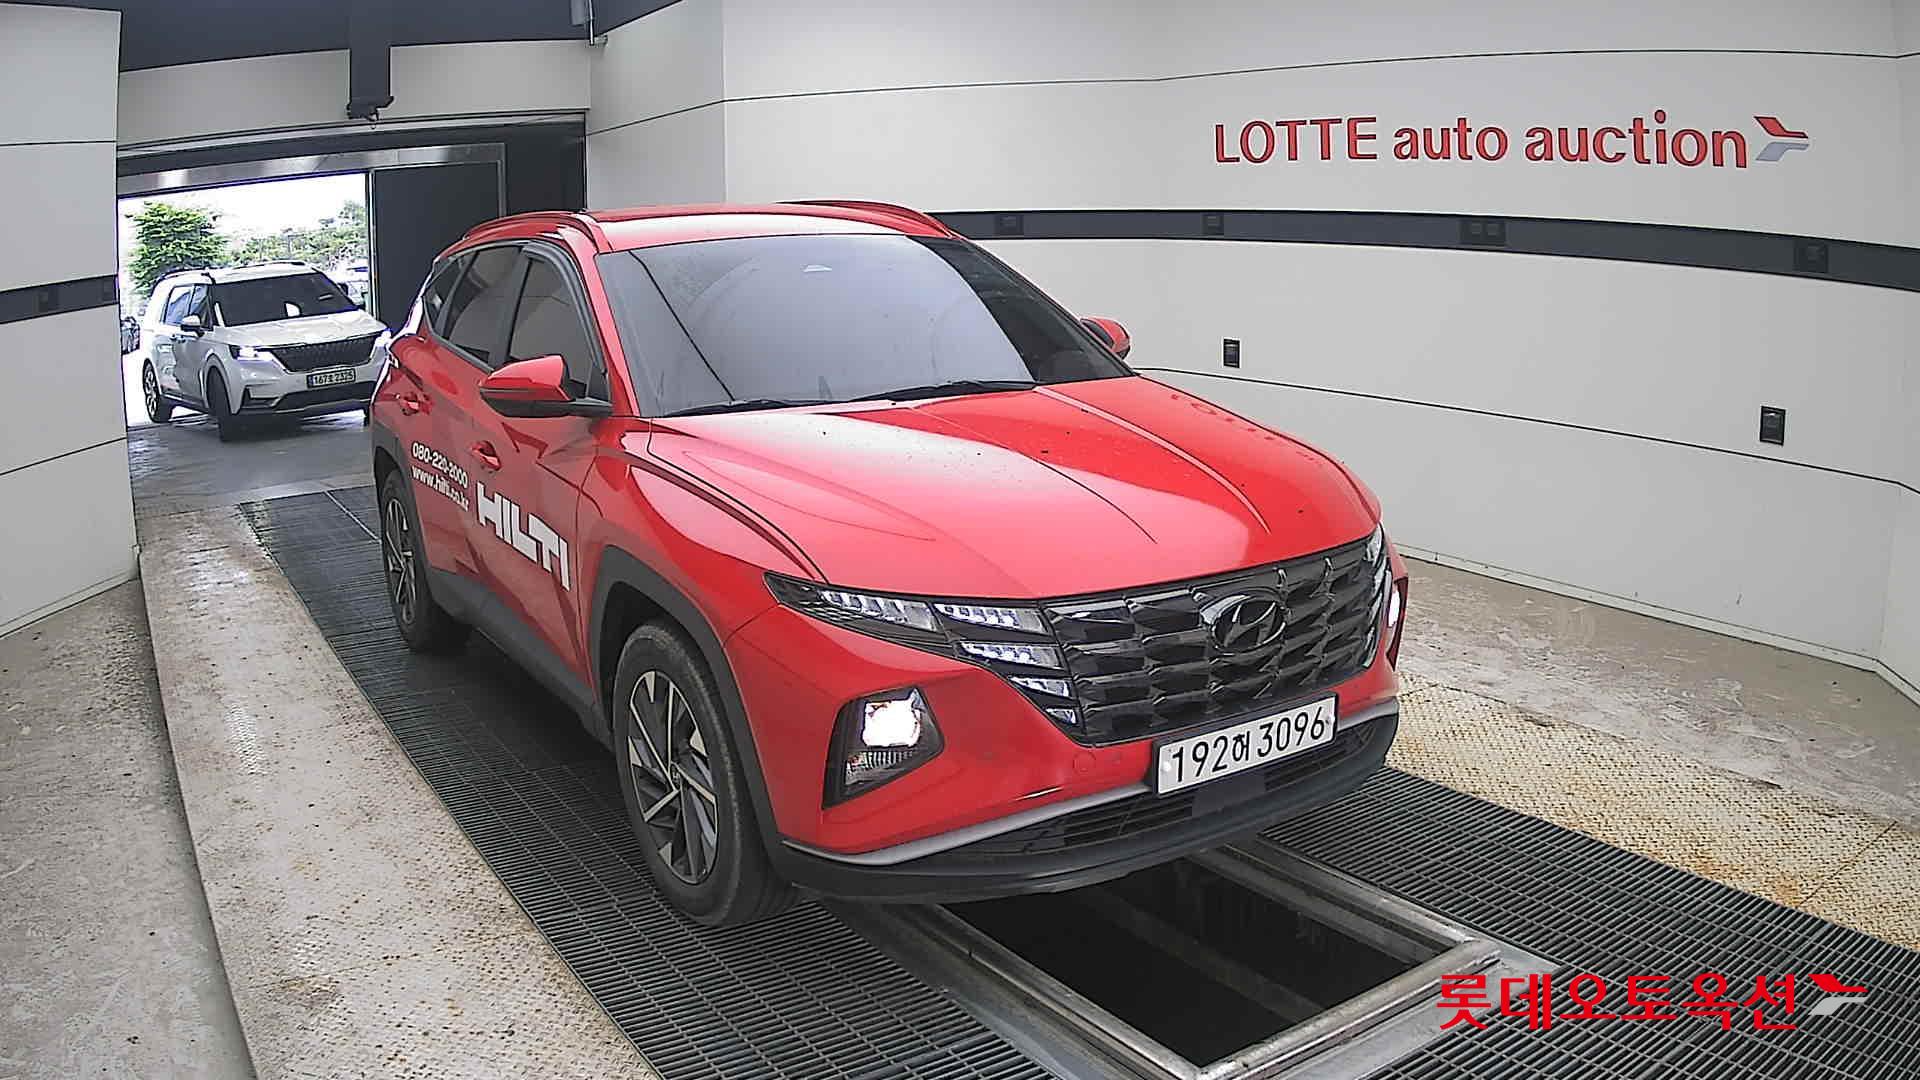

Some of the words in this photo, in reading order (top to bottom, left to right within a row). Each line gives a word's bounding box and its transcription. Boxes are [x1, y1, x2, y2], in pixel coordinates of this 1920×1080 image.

[1215, 116, 1378, 164] LOTTE
[1393, 117, 1509, 162] auto
[1524, 109, 1748, 168] auction
[411, 465, 470, 512] www.hilti.co.kr
[412, 442, 469, 489] 080-220-2000
[477, 481, 571, 592] HILTI
[1172, 730, 1251, 783] 192허
[1257, 706, 1325, 758] 3096
